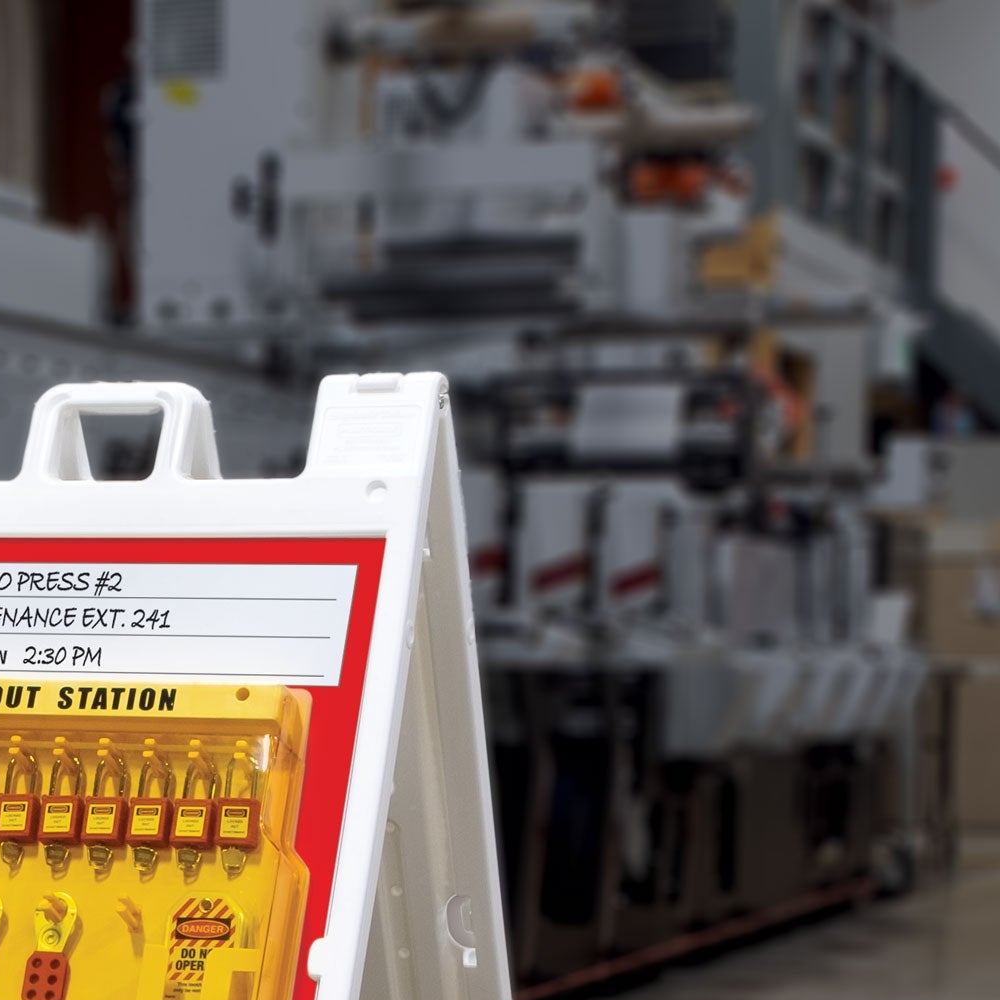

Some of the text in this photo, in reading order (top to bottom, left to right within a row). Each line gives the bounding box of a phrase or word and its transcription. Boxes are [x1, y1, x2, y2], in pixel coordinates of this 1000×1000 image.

[18, 572, 90, 591] PRESS
[95, 572, 121, 595] #2
[83, 608, 125, 629] EXT.
[131, 609, 170, 629] 241
[23, 646, 66, 665] 2:30
[73, 646, 101, 666] PM
[58, 687, 176, 711] STATION
[181, 924, 224, 934] DANGER
[181, 948, 196, 959] DO
